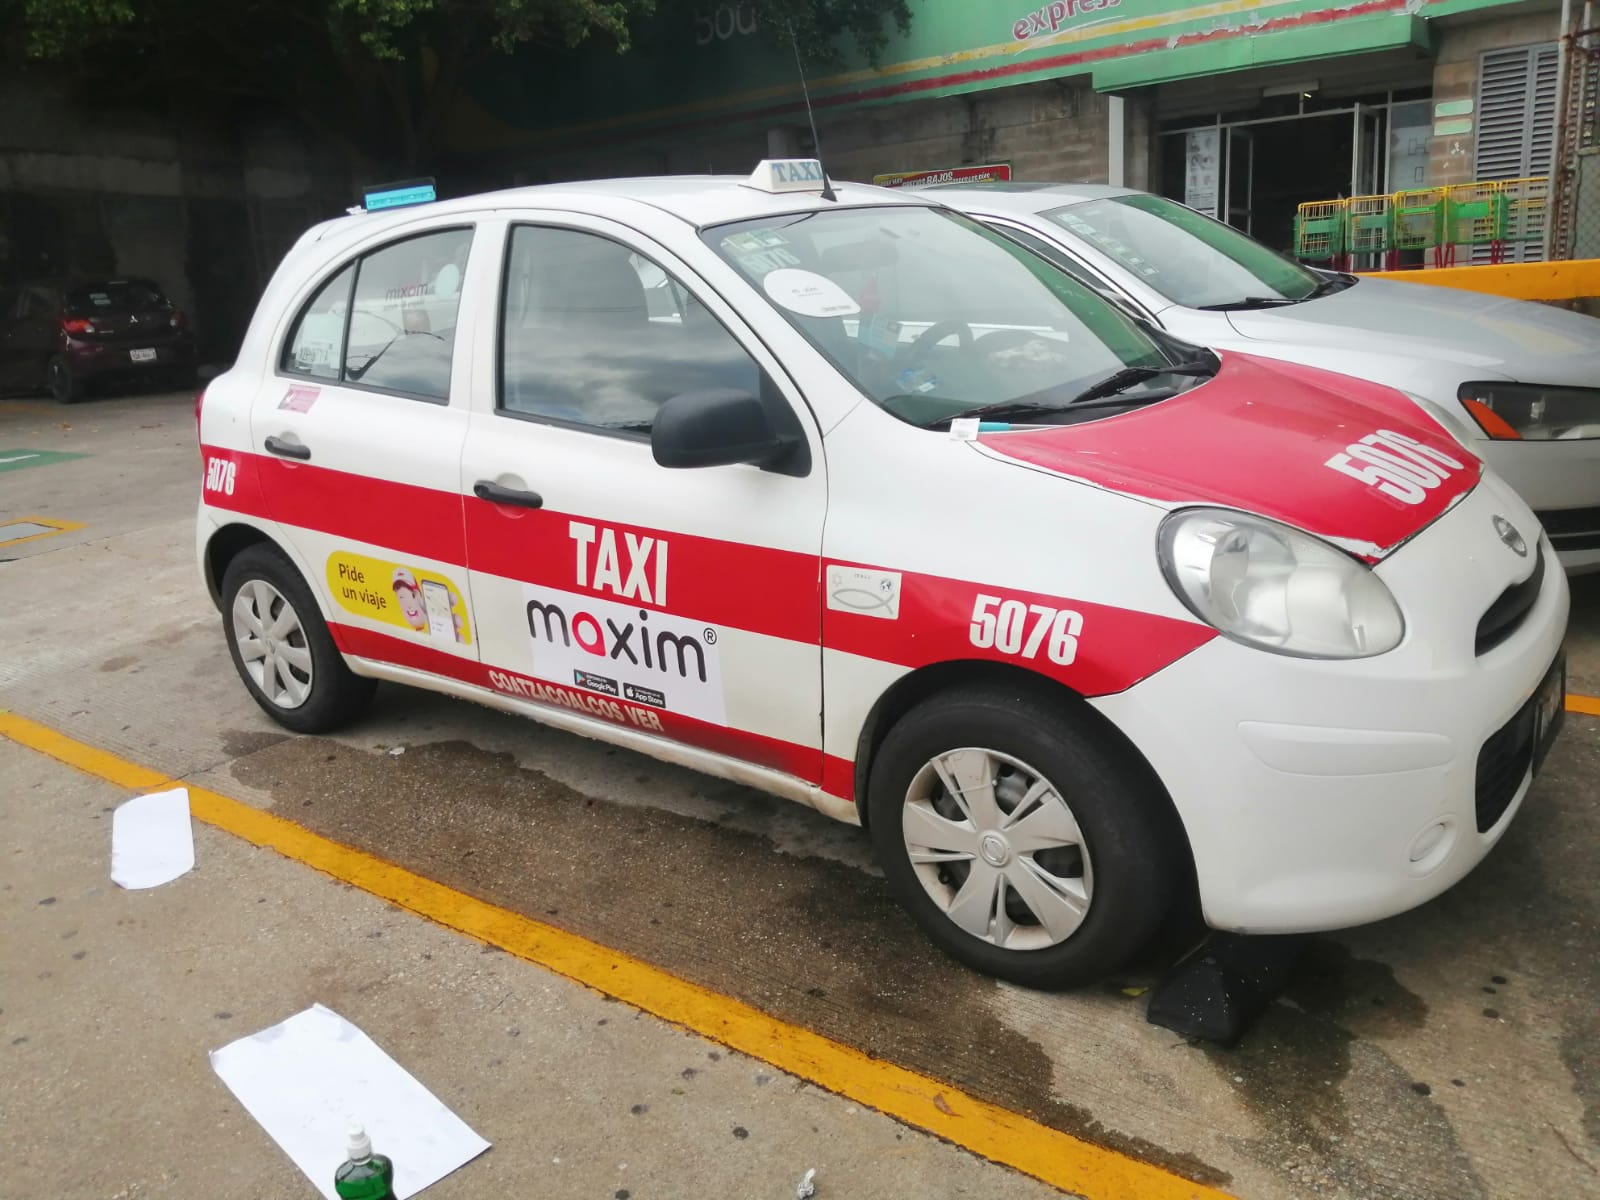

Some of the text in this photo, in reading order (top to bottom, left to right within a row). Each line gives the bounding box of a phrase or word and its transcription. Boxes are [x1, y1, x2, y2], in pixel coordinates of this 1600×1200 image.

[1013, 0, 1120, 40] expre
[771, 162, 823, 182] TAXI
[206, 457, 236, 495] 5076
[1324, 429, 1464, 505] 5076
[338, 563, 364, 583] Pide
[569, 520, 668, 607] TAXI
[342, 586, 387, 610] un viaje
[969, 593, 1083, 666] 5076
[488, 670, 664, 731] COATZACOALCOS VER
[586, 679, 617, 694] Google Play
[635, 692, 647, 702] App
